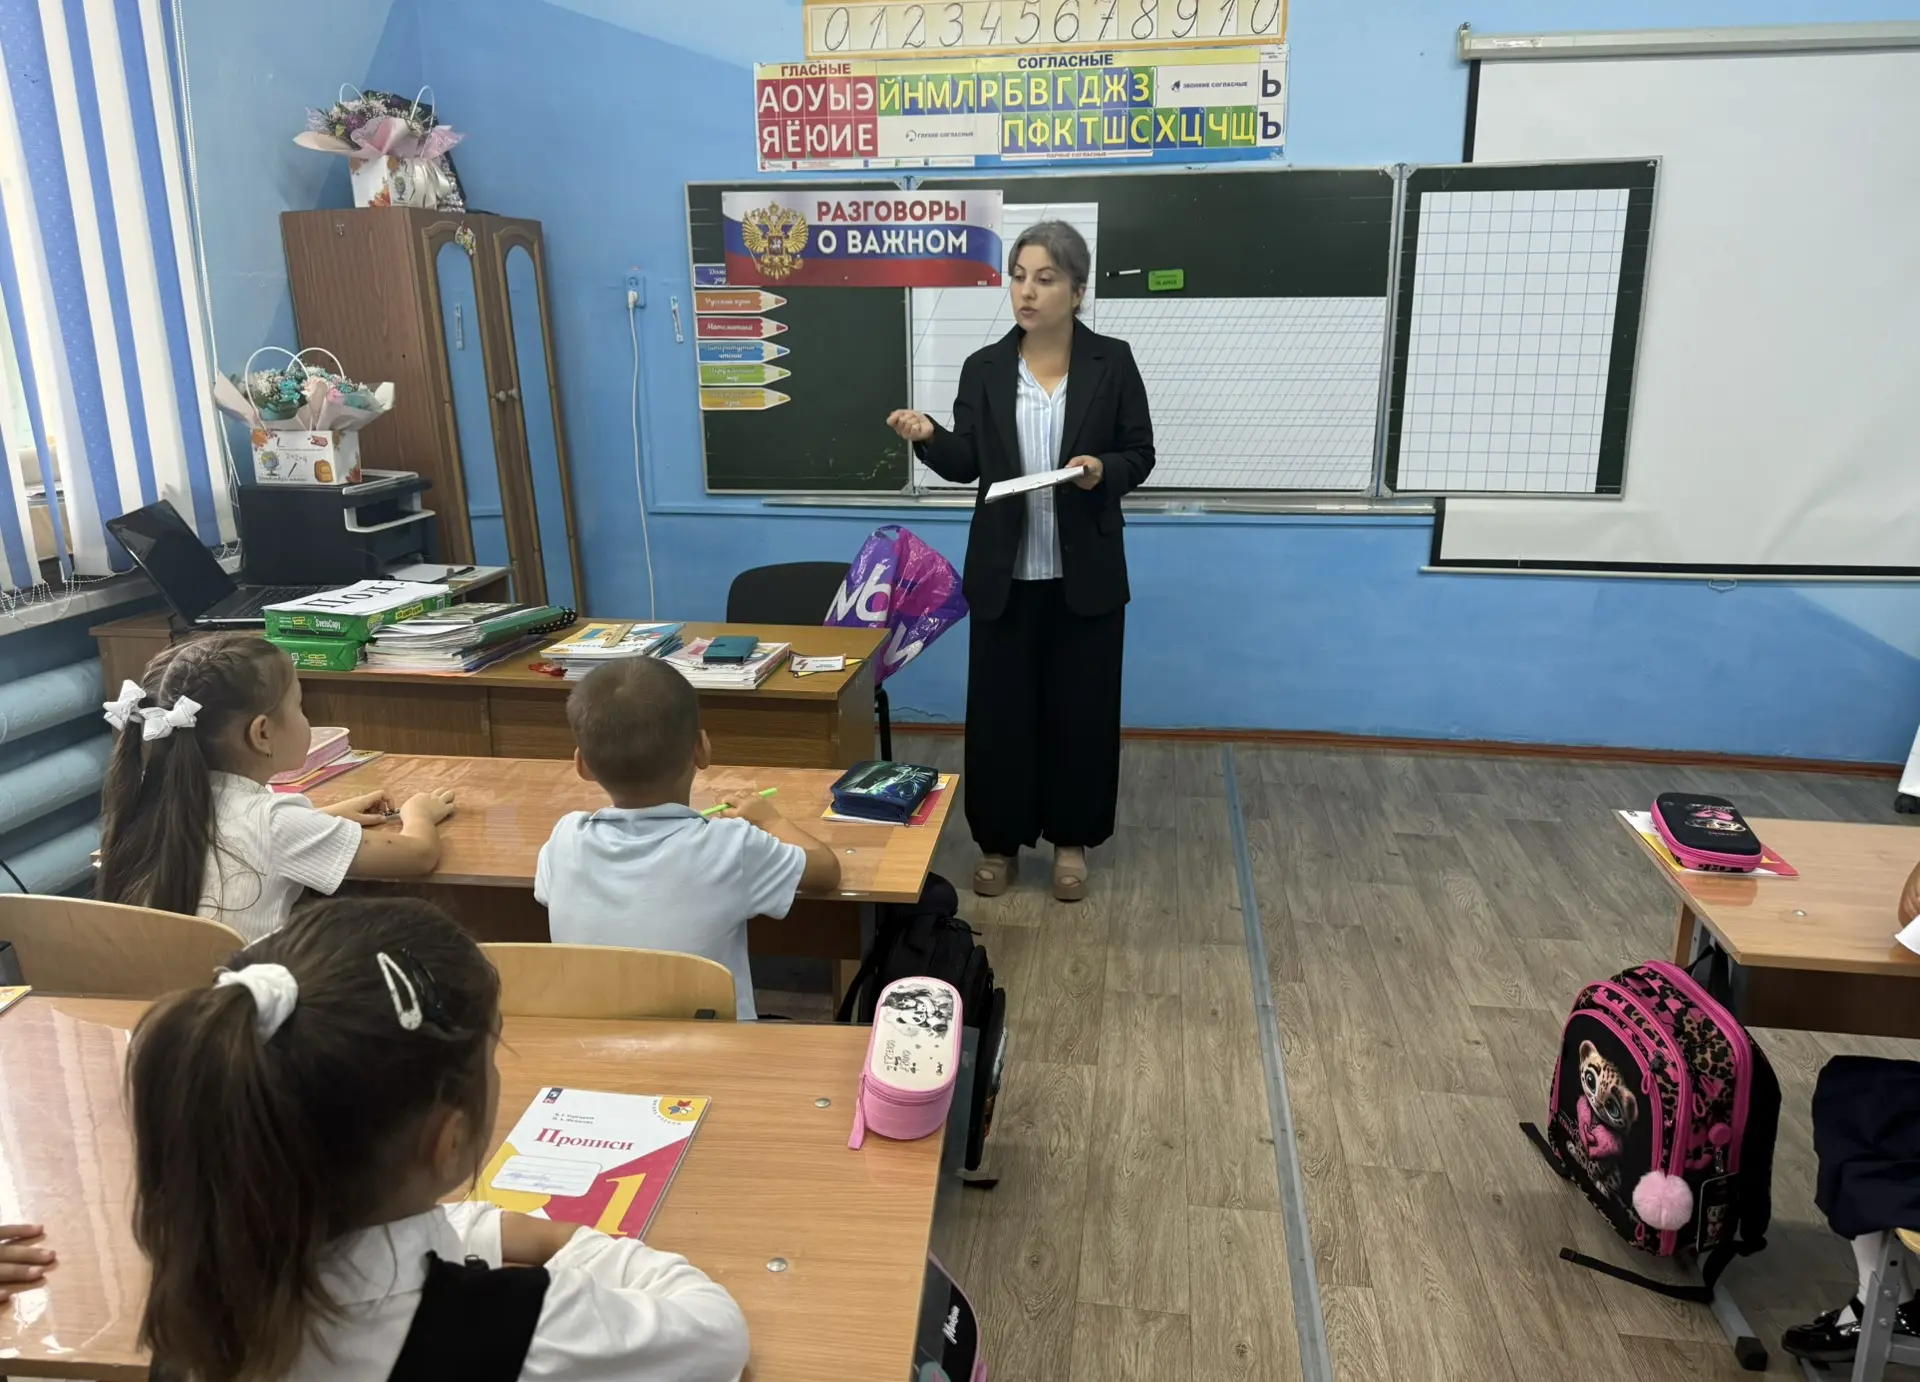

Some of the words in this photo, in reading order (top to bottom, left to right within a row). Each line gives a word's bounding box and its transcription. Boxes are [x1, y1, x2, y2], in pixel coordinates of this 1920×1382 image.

[824, 6, 850, 51] 0
[869, 6, 887, 49] 1
[901, 4, 926, 49] 2
[938, 2, 964, 47] 3
[980, 2, 1001, 46] 4
[1014, 0, 1041, 44] 5
[1053, 0, 1080, 43] 6
[1130, 0, 1159, 40] 8
[1171, 0, 1198, 39] 9
[780, 63, 852, 77] ГЛАСНЫЕ
[1017, 53, 1114, 70] СОГЛАСНЫЕ
[816, 200, 967, 222] РАЗГОВОРЫ
[816, 229, 838, 254] О
[846, 229, 968, 255] ВАЖНОМ
[534, 1127, 634, 1151] Прописи
[592, 1172, 647, 1236] 1
